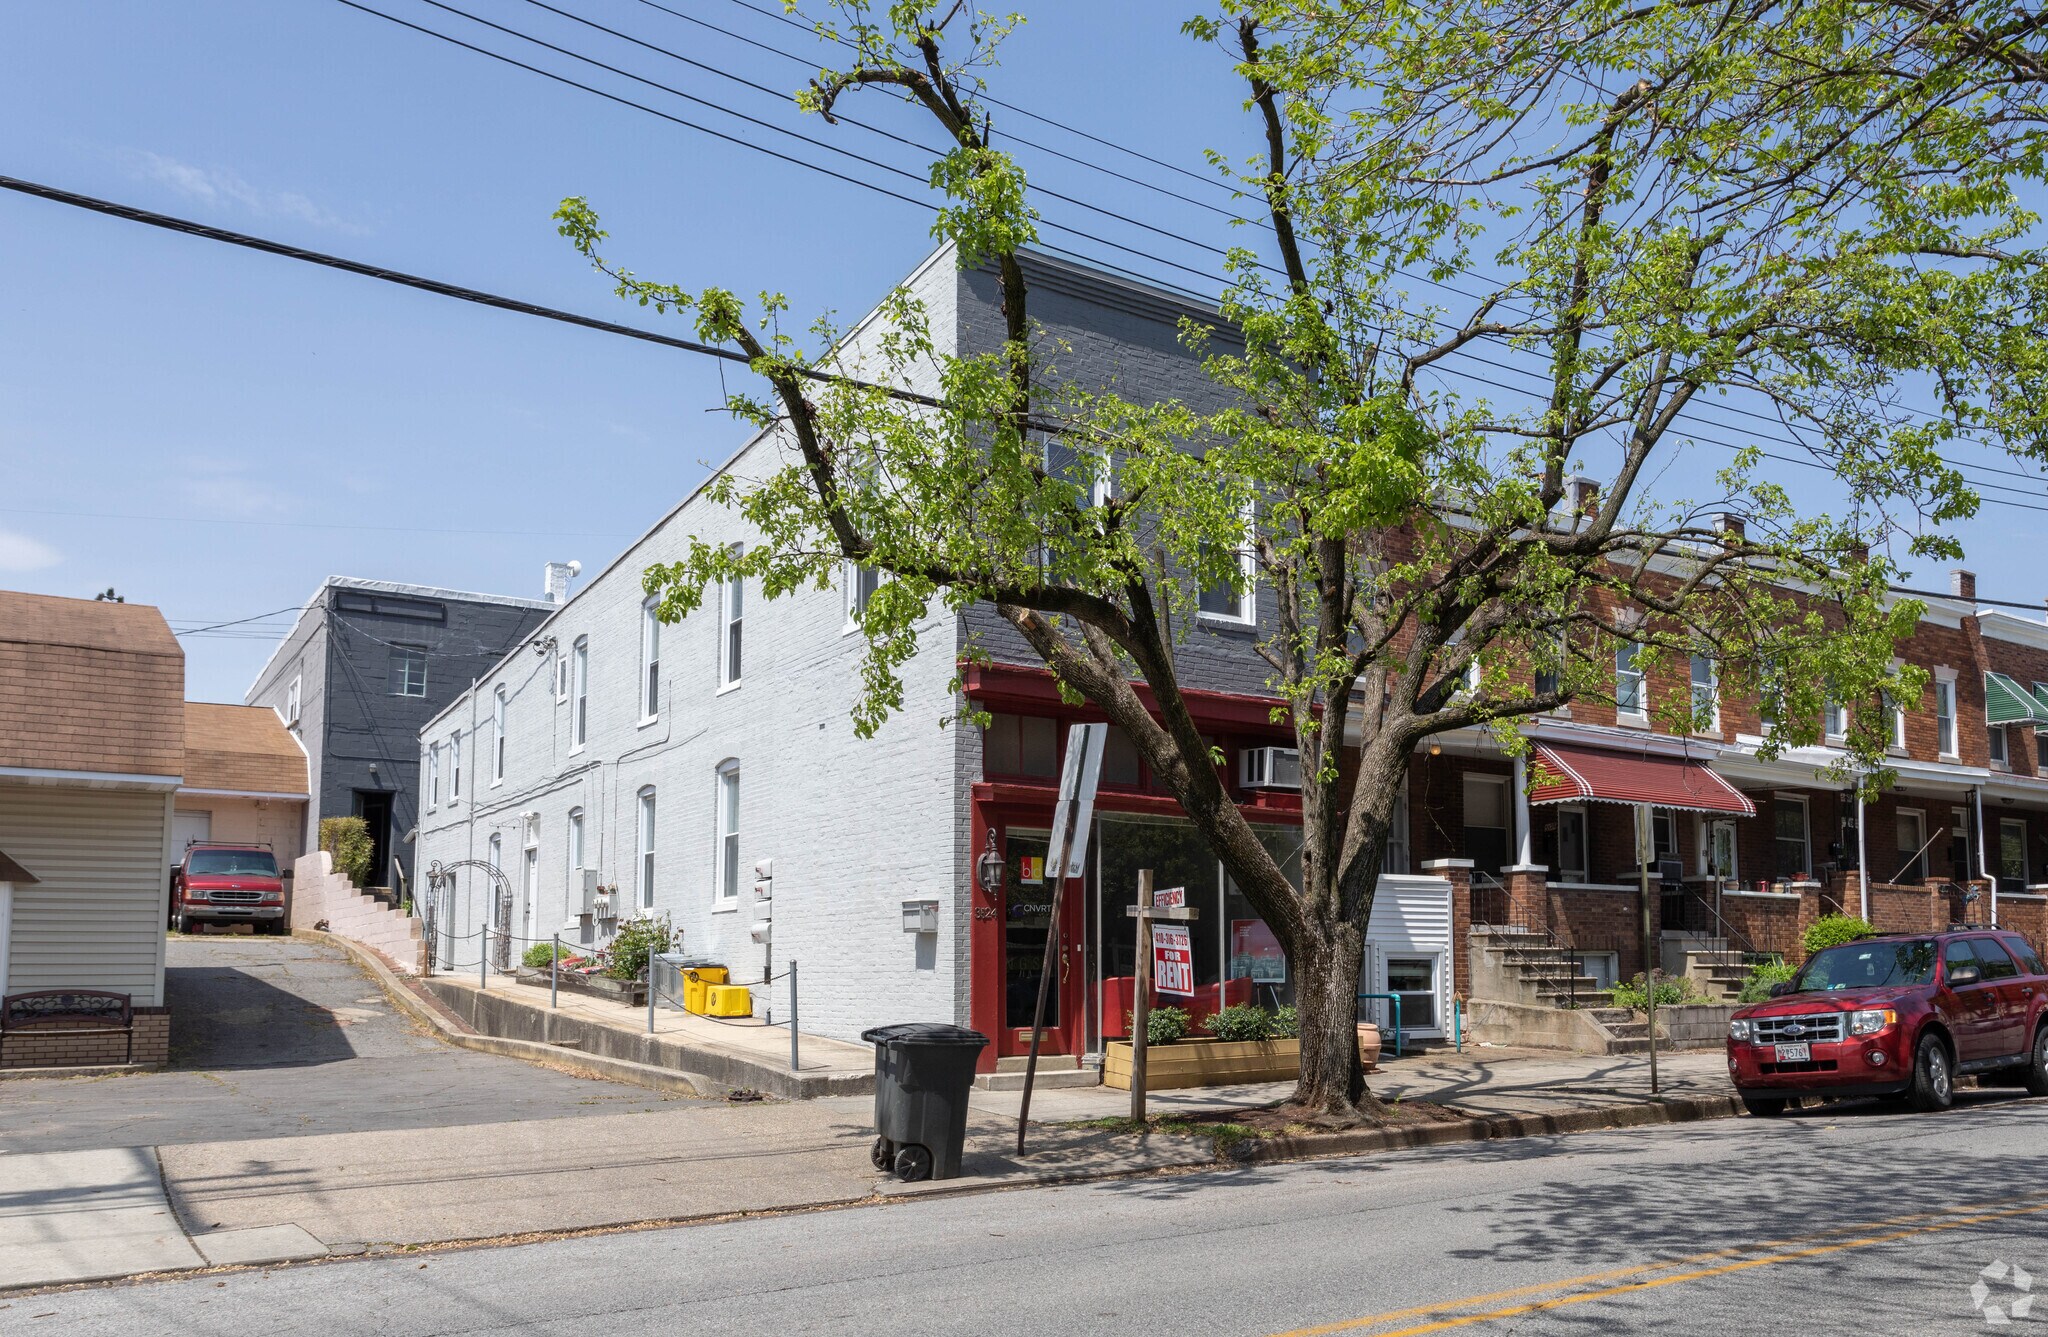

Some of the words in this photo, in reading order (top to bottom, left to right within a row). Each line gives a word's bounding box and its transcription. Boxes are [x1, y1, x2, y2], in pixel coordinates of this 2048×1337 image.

[1155, 891, 1183, 908] EFFICIENCY
[1165, 950, 1181, 962] FOR
[1157, 960, 1190, 991] RENT
